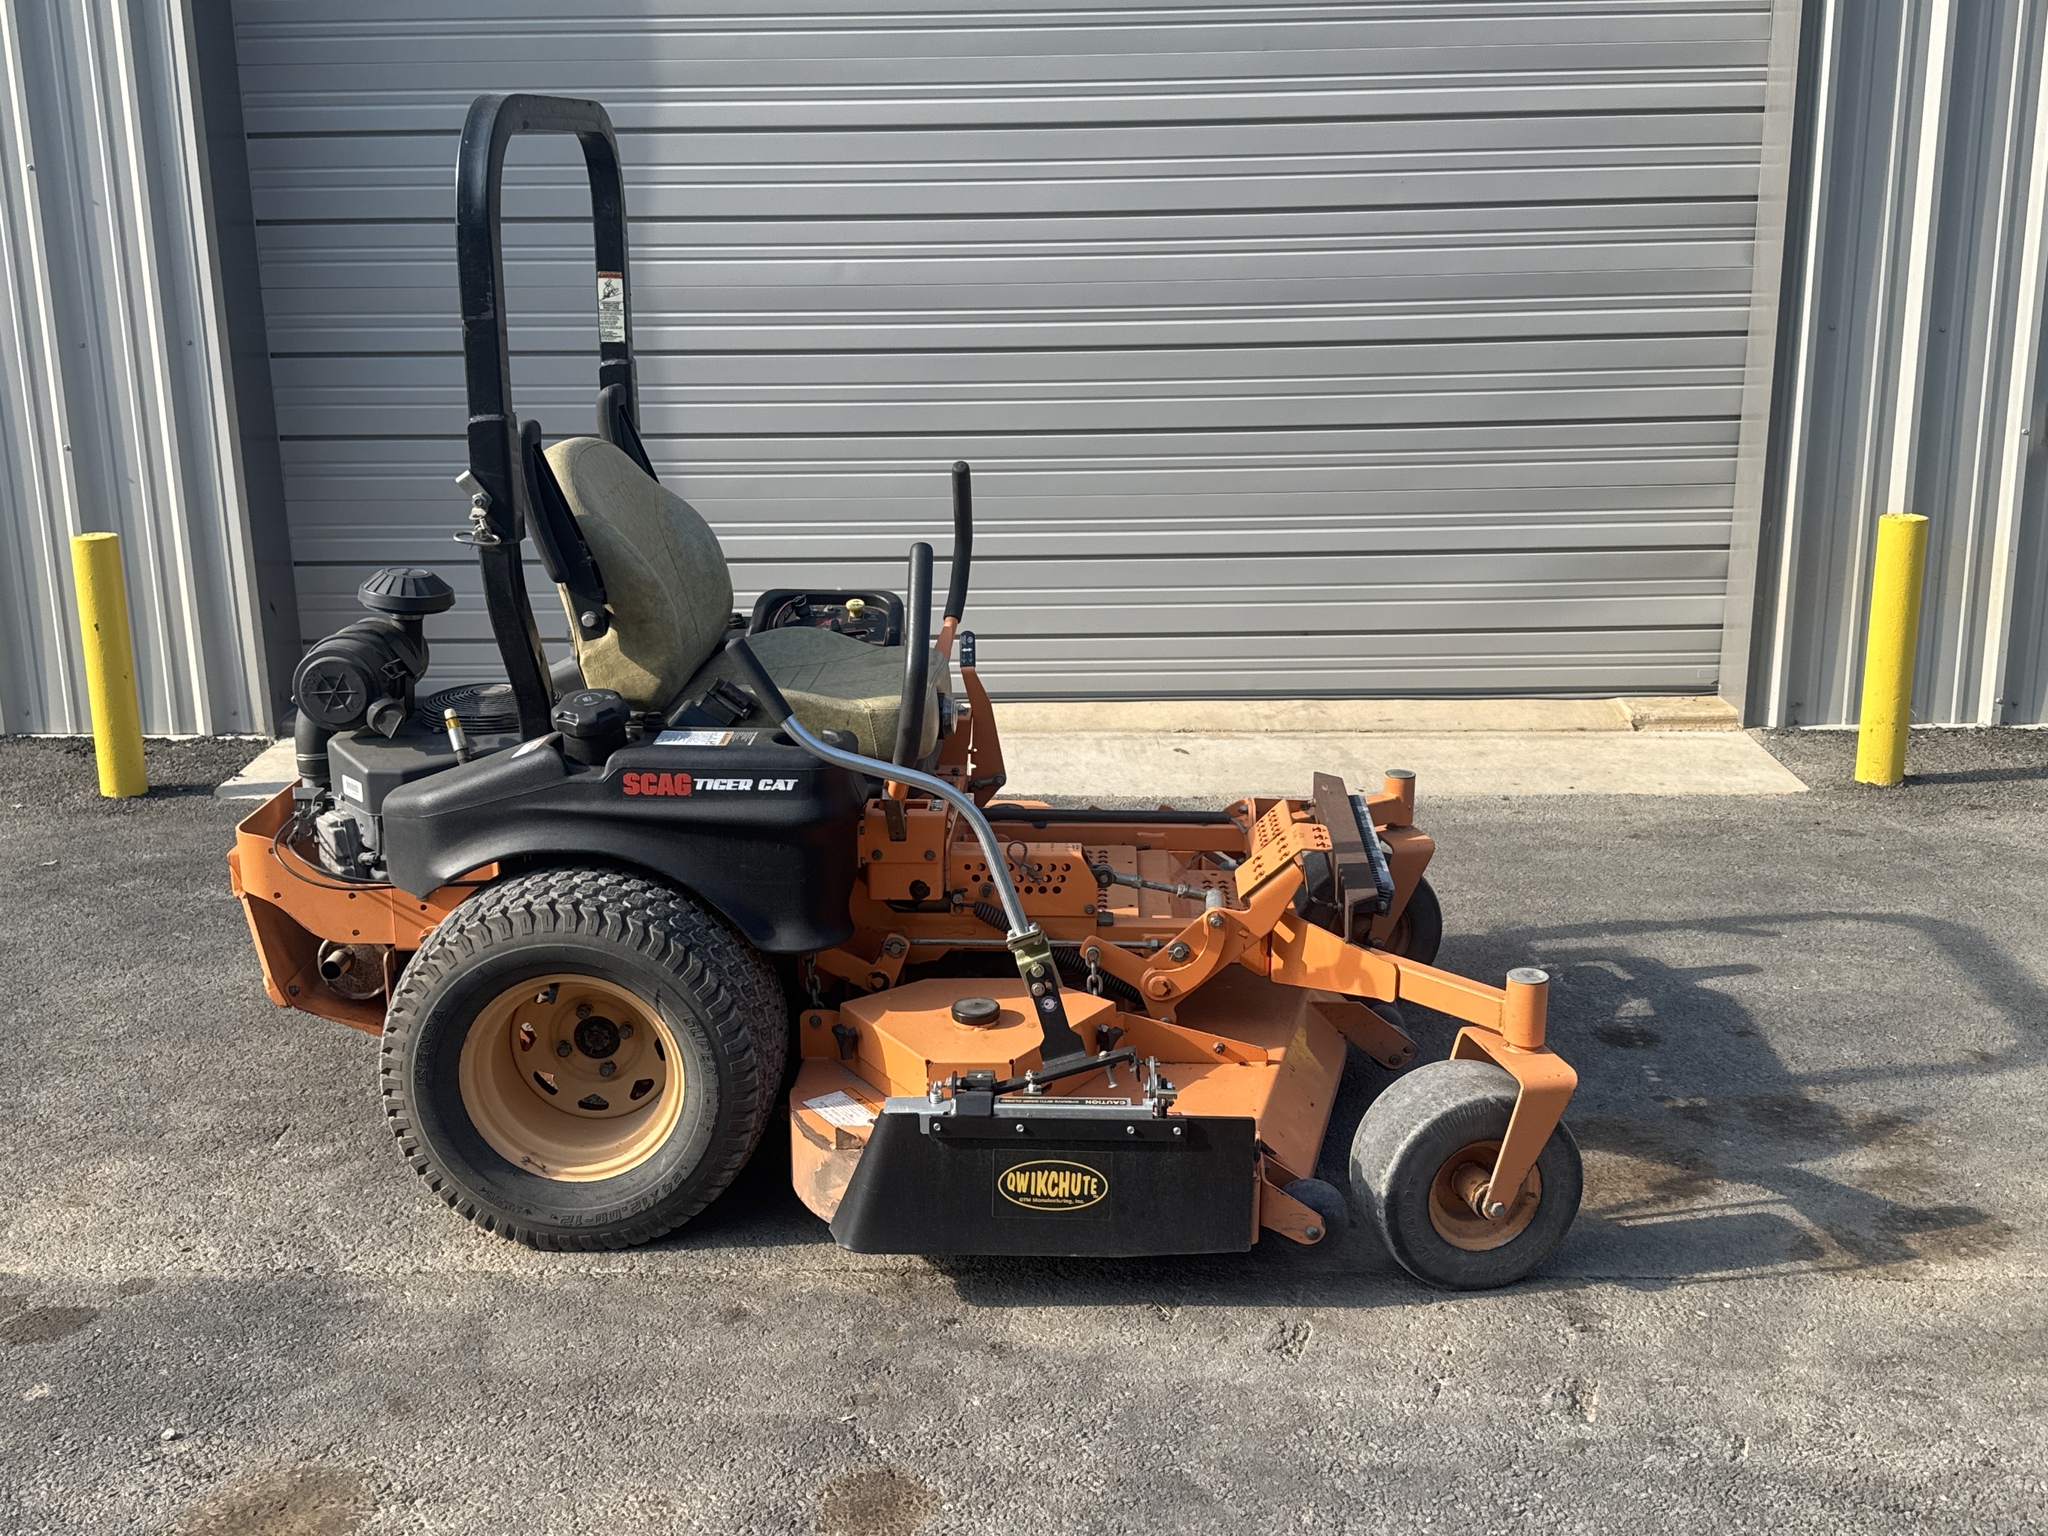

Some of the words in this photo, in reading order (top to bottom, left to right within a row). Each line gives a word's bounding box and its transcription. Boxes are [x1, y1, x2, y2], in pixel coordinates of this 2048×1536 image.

[623, 772, 692, 796] SCAG
[693, 778, 753, 791] TIGER
[757, 778, 798, 791] CAT
[415, 1009, 446, 1087] KENDA
[683, 1016, 717, 1076] SUPER
[1006, 1170, 1098, 1198] QWIKCHUTE
